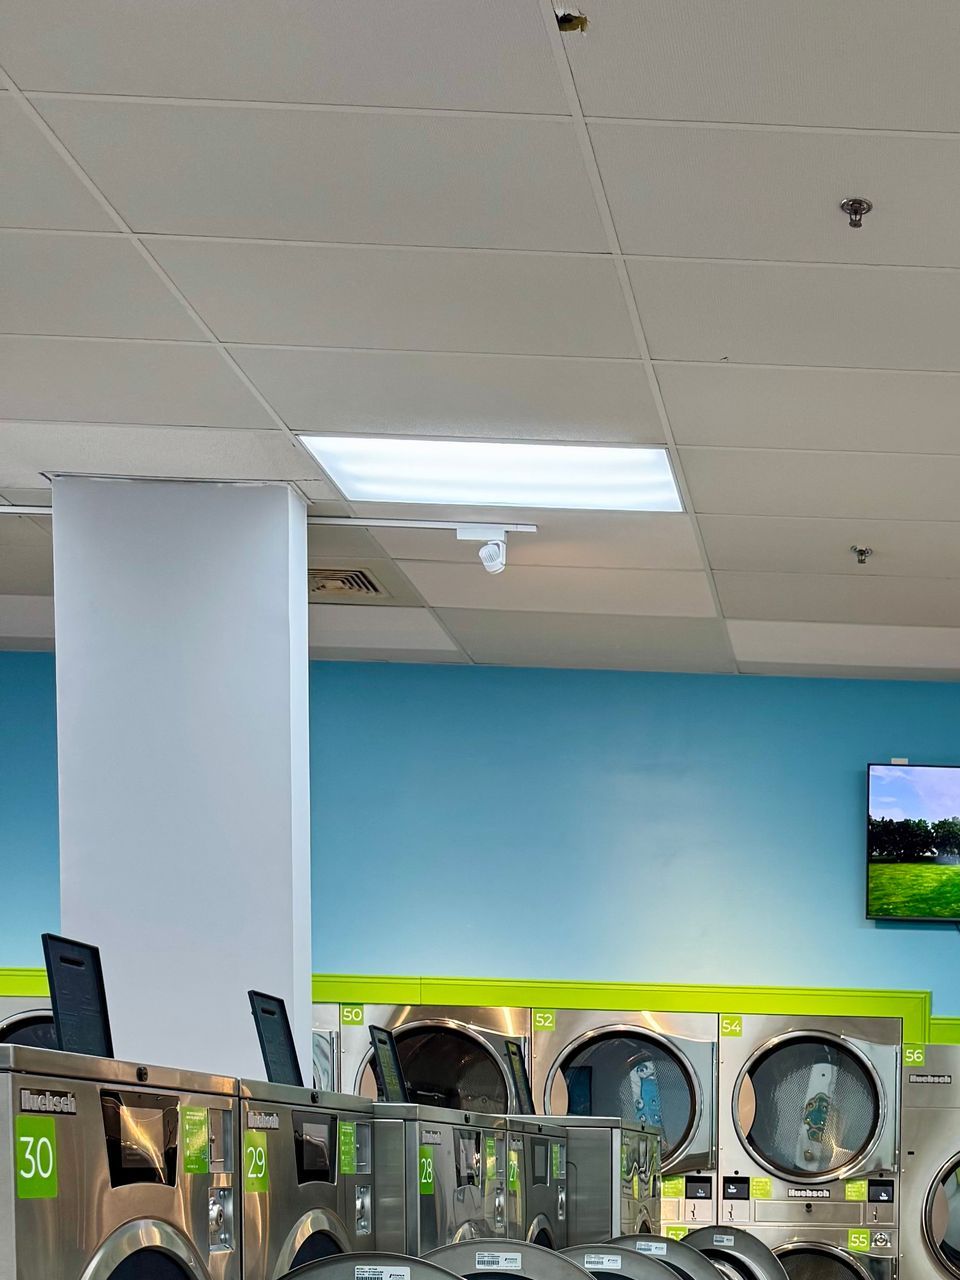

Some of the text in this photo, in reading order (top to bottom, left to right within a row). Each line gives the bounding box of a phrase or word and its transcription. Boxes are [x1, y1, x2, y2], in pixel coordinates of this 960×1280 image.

[343, 1008, 362, 1021] 50
[535, 1013, 553, 1027] 52
[722, 1019, 742, 1033] 54
[905, 1049, 923, 1062] 56
[21, 1089, 76, 1113] Huebsch
[20, 1136, 53, 1178] 30
[247, 1146, 265, 1178] 29
[421, 1158, 433, 1183] 28
[788, 1189, 830, 1198] Huebsch
[851, 1234, 868, 1247] 55
